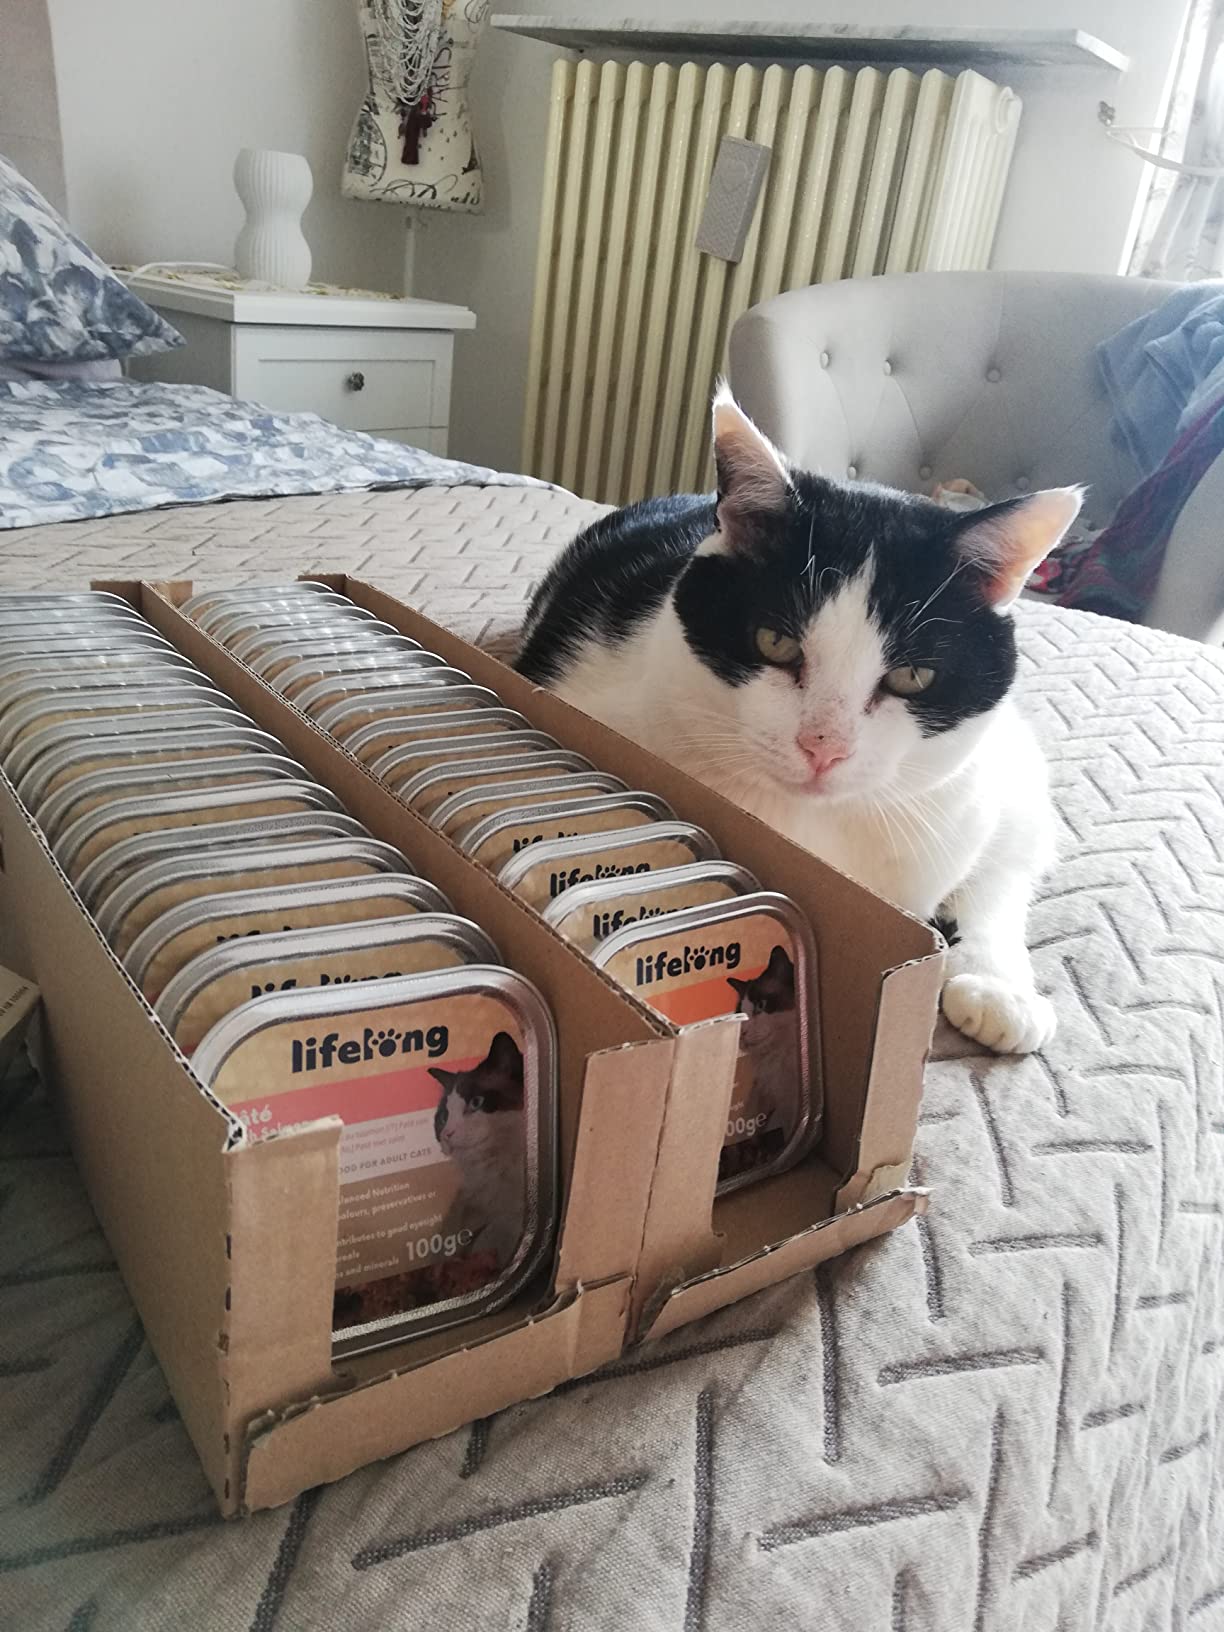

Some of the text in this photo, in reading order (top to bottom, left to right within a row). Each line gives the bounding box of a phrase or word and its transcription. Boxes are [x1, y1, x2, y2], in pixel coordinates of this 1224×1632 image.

[636, 940, 741, 986] lifelong
[291, 1025, 449, 1073] lifelong
[379, 1151, 408, 1167] ADULT
[410, 1146, 433, 1159] CATS
[337, 1208, 371, 1221] olours,
